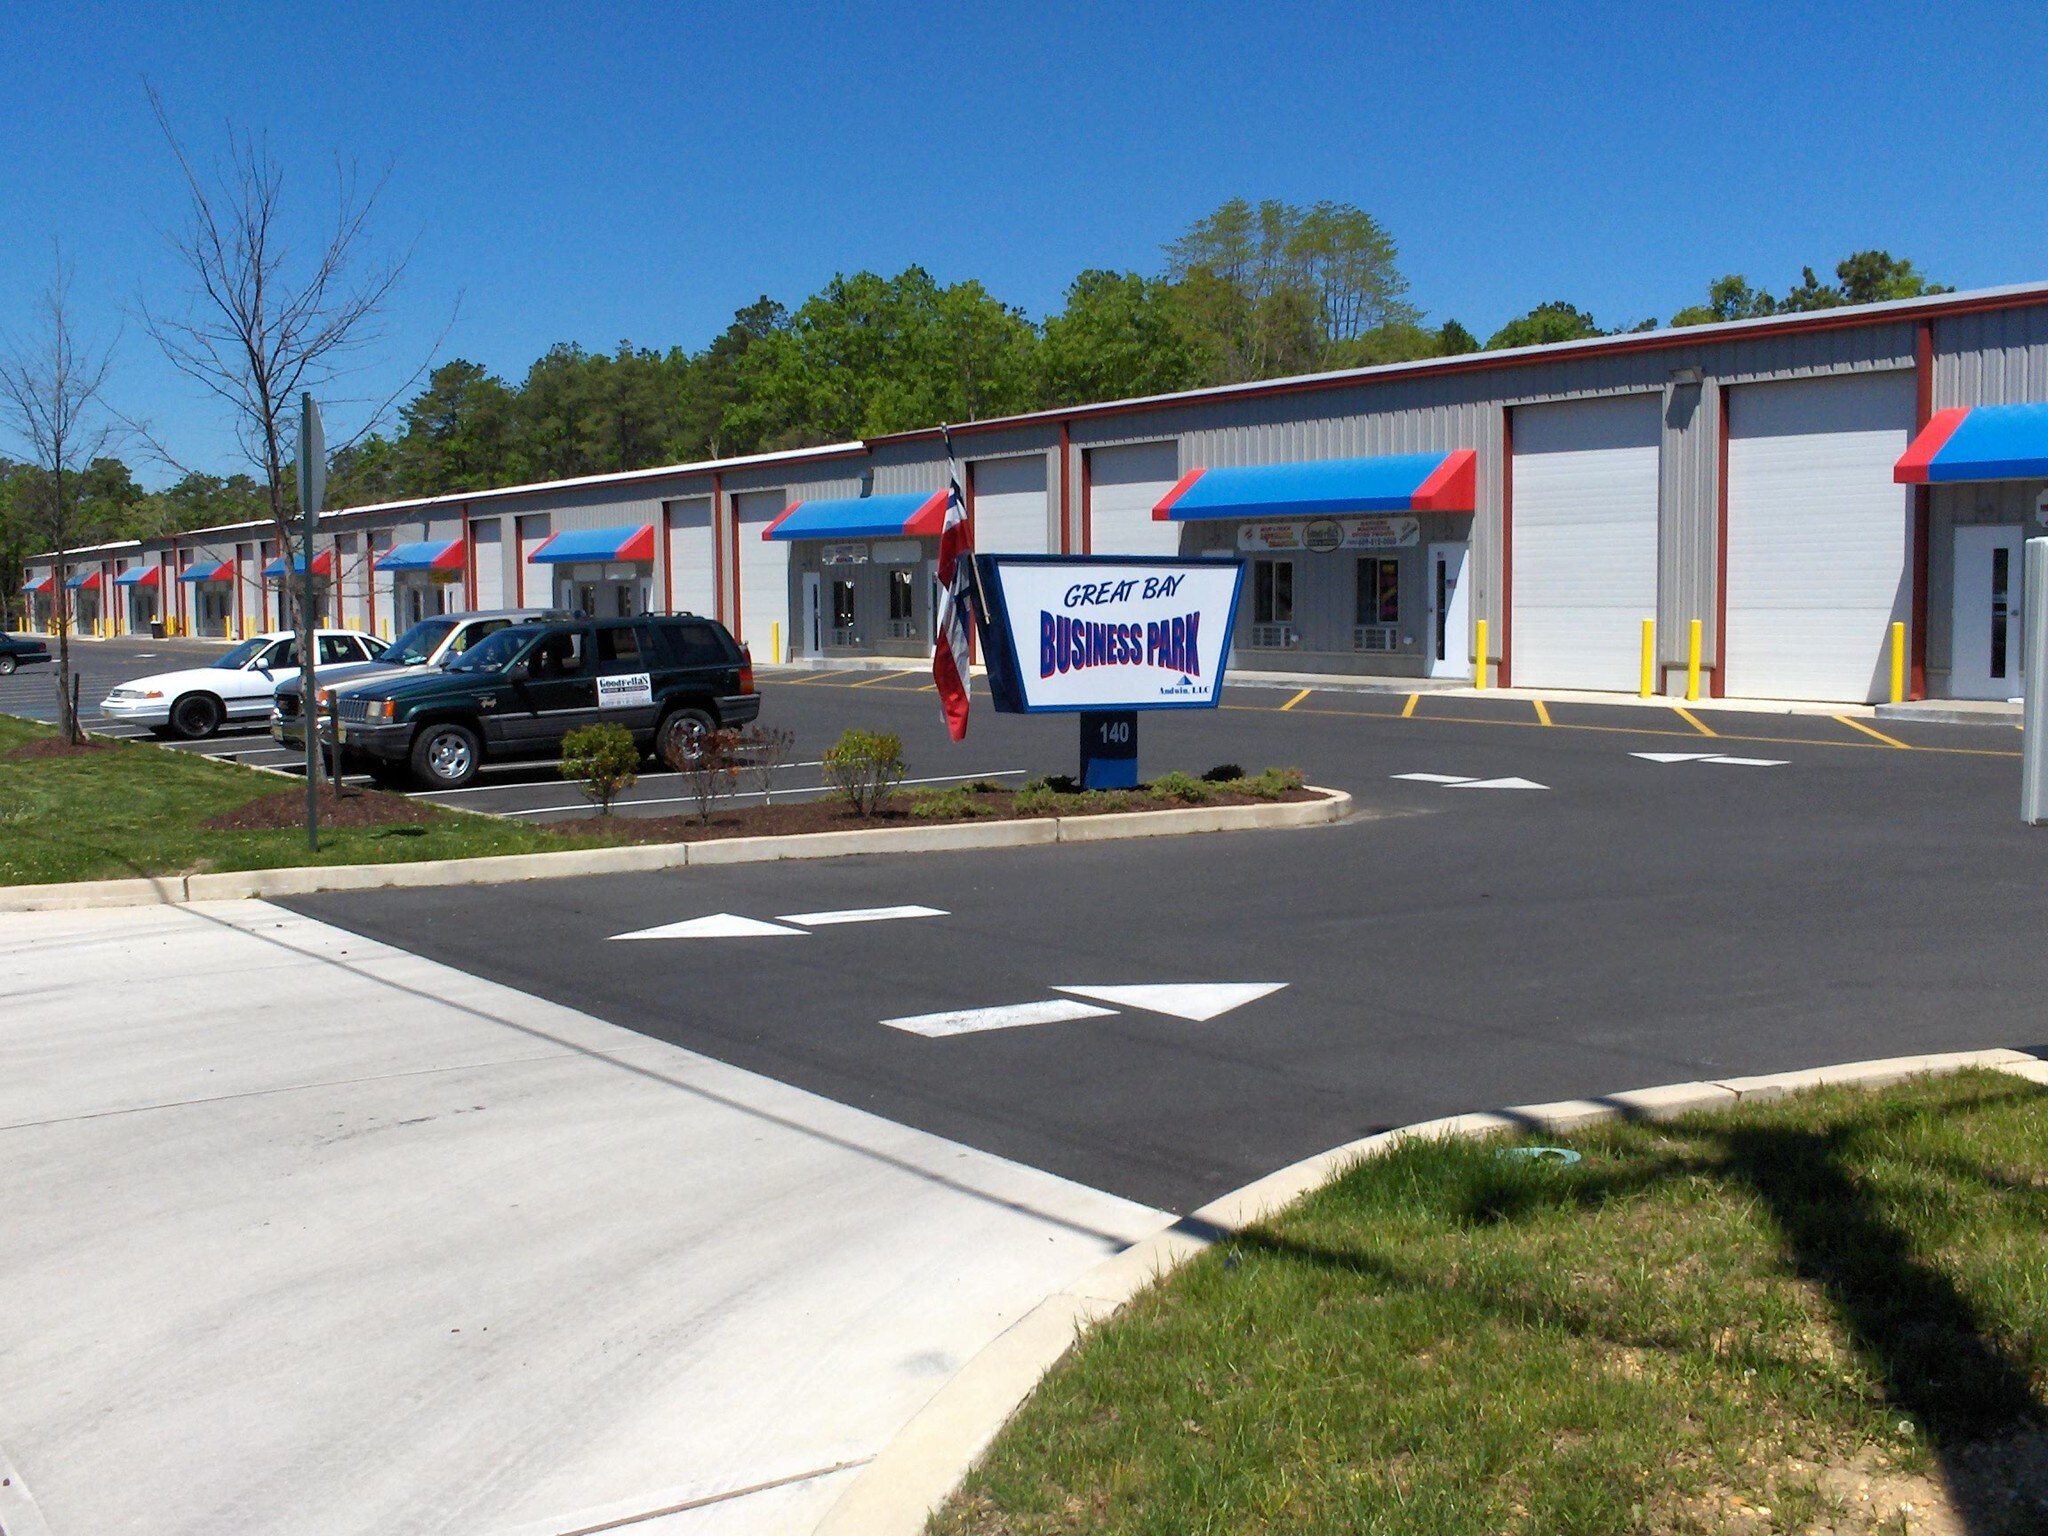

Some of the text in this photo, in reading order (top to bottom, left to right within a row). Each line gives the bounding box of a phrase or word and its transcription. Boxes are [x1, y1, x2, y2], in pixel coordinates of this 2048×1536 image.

[1064, 574, 1185, 608] GREAT BAY
[1040, 609, 1201, 679] BUSINESS PARK
[1100, 722, 1129, 743] 140
